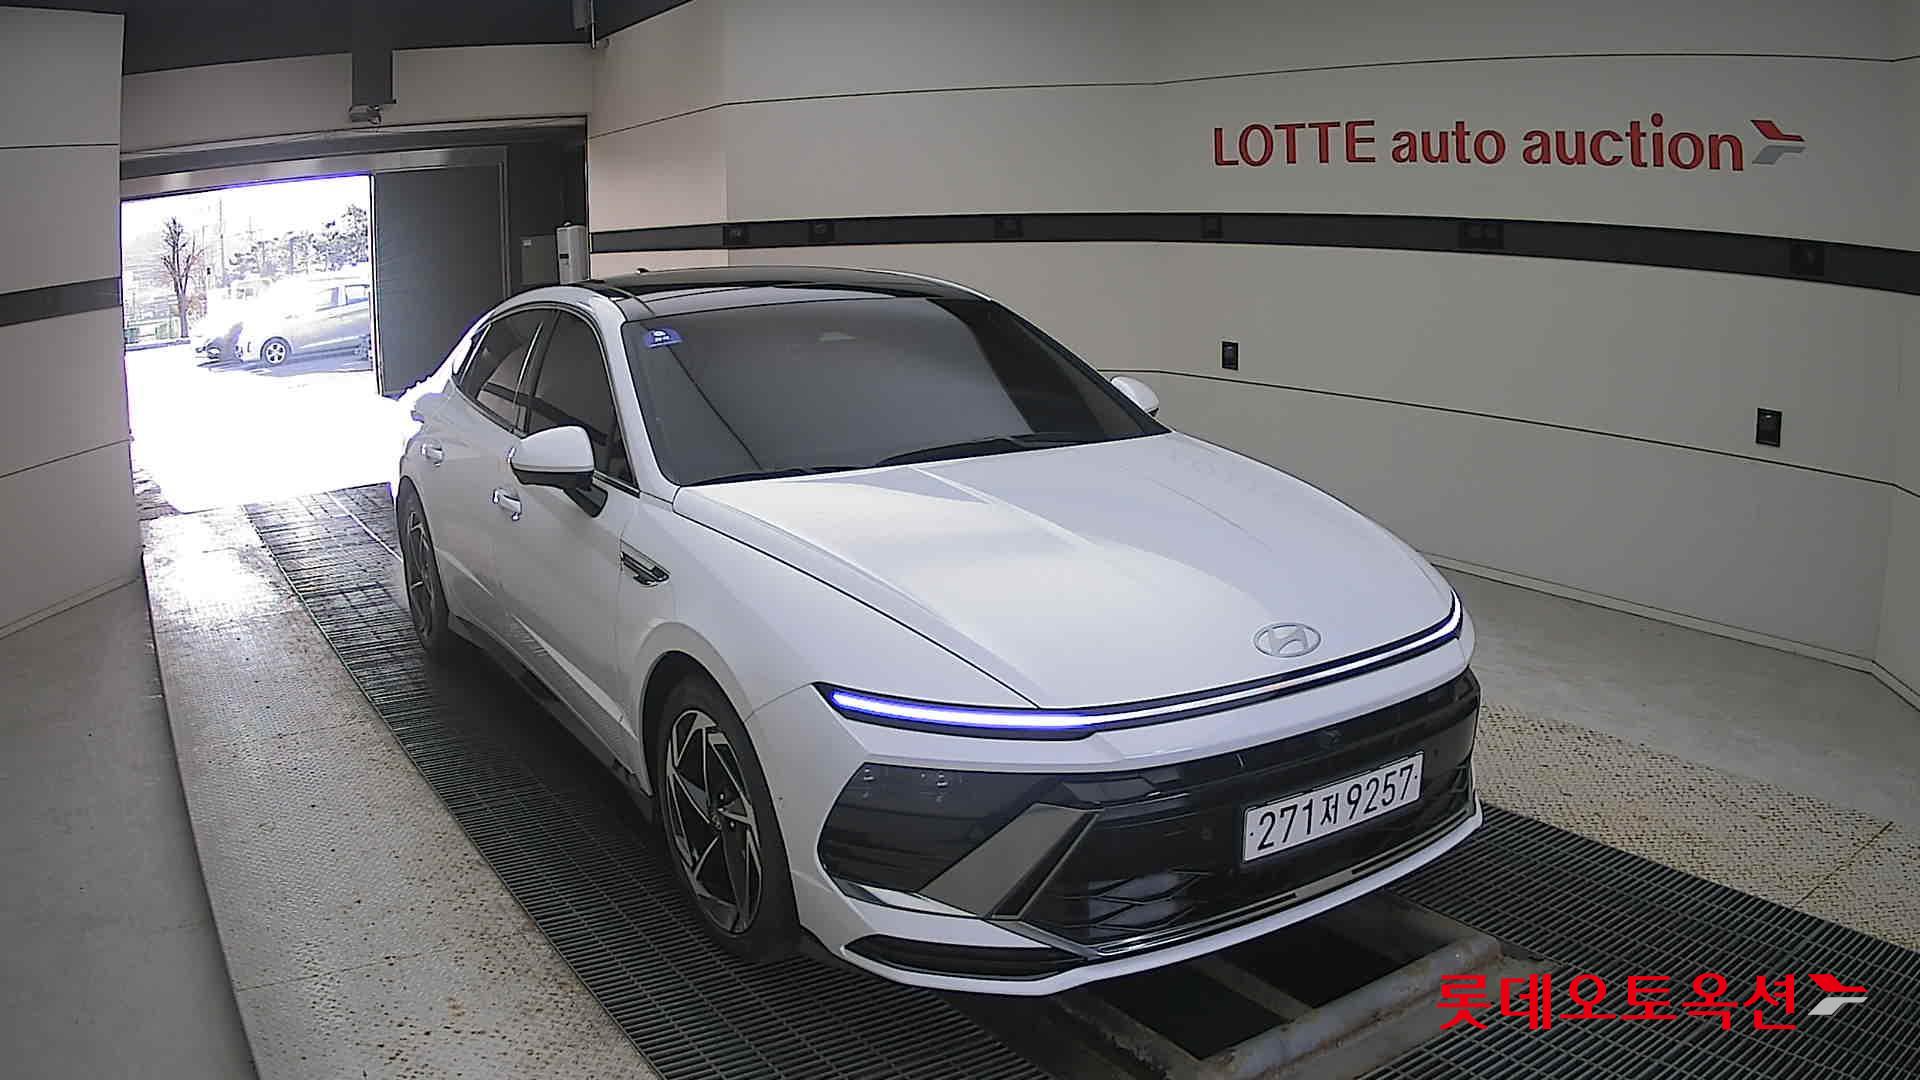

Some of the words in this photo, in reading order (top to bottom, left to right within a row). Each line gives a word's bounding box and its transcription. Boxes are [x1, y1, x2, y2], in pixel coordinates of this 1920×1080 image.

[1213, 120, 1376, 166] LOTTE
[1391, 121, 1506, 164] auto
[1522, 113, 1744, 171] auction
